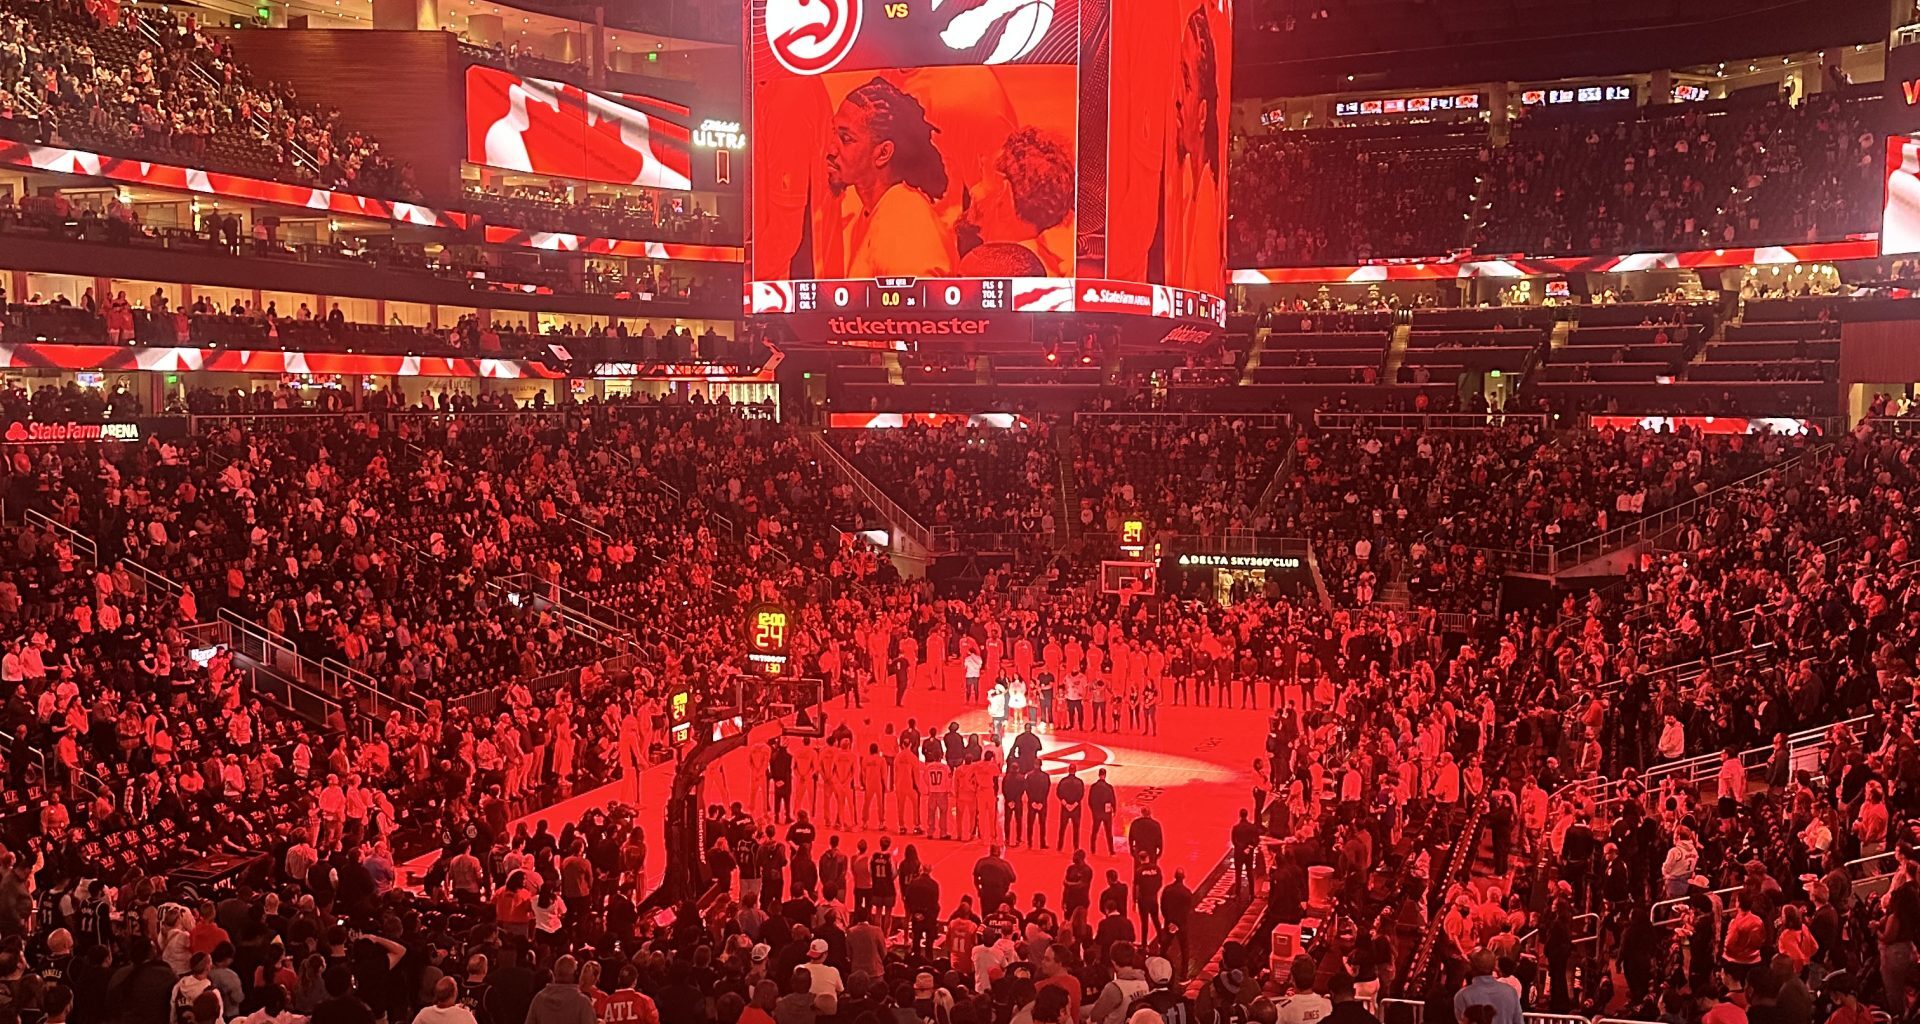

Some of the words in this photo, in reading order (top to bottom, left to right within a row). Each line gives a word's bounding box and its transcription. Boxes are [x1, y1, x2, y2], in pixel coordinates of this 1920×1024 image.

[884, 3, 909, 19] VS
[834, 287, 849, 307] 0
[881, 292, 900, 306] 0.0
[944, 286, 961, 306] 0
[982, 290, 996, 299] TOL
[828, 316, 990, 335] ticketmaster
[100, 423, 139, 439] ARENA
[1123, 529, 1141, 542] 24
[1190, 554, 1228, 565] DELTA
[756, 624, 783, 648] 24
[604, 1001, 638, 1022] ATL
[1302, 1009, 1320, 1021] JONES
